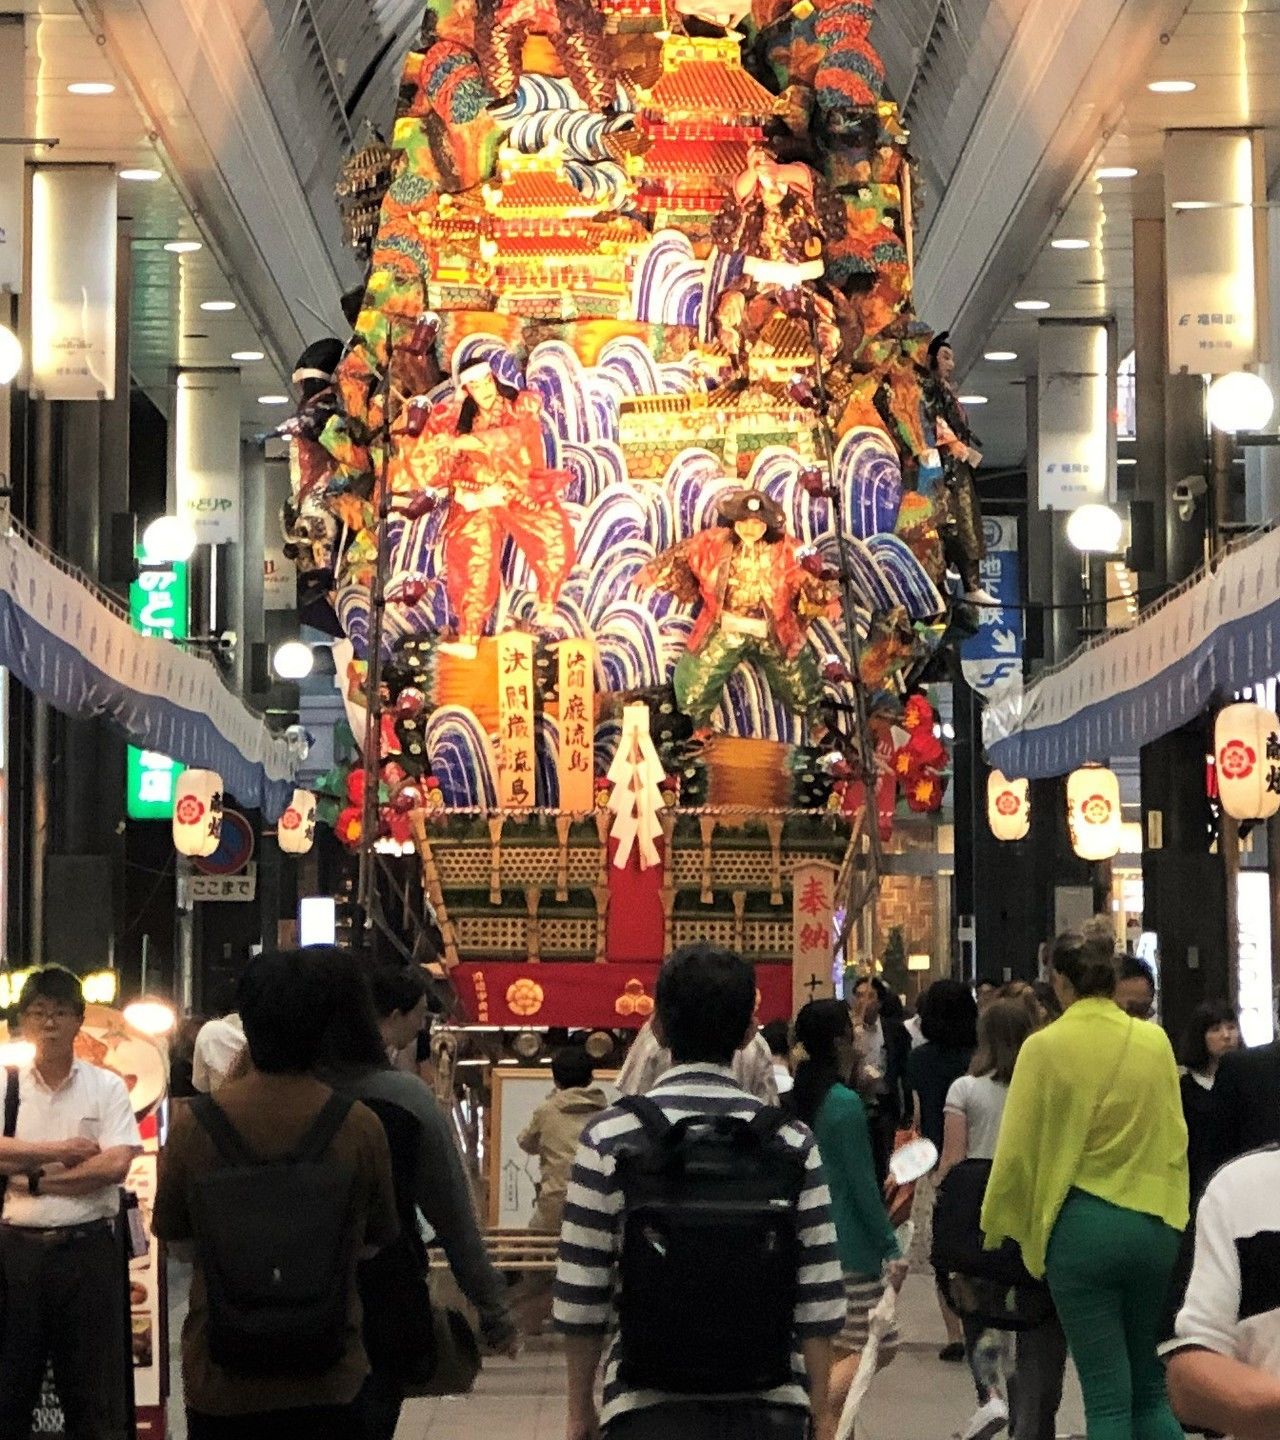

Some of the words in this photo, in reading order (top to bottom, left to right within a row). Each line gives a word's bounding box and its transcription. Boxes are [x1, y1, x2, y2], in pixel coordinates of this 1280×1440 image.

[193, 880, 251, 896] ここまで
[799, 875, 831, 955] 奉納
